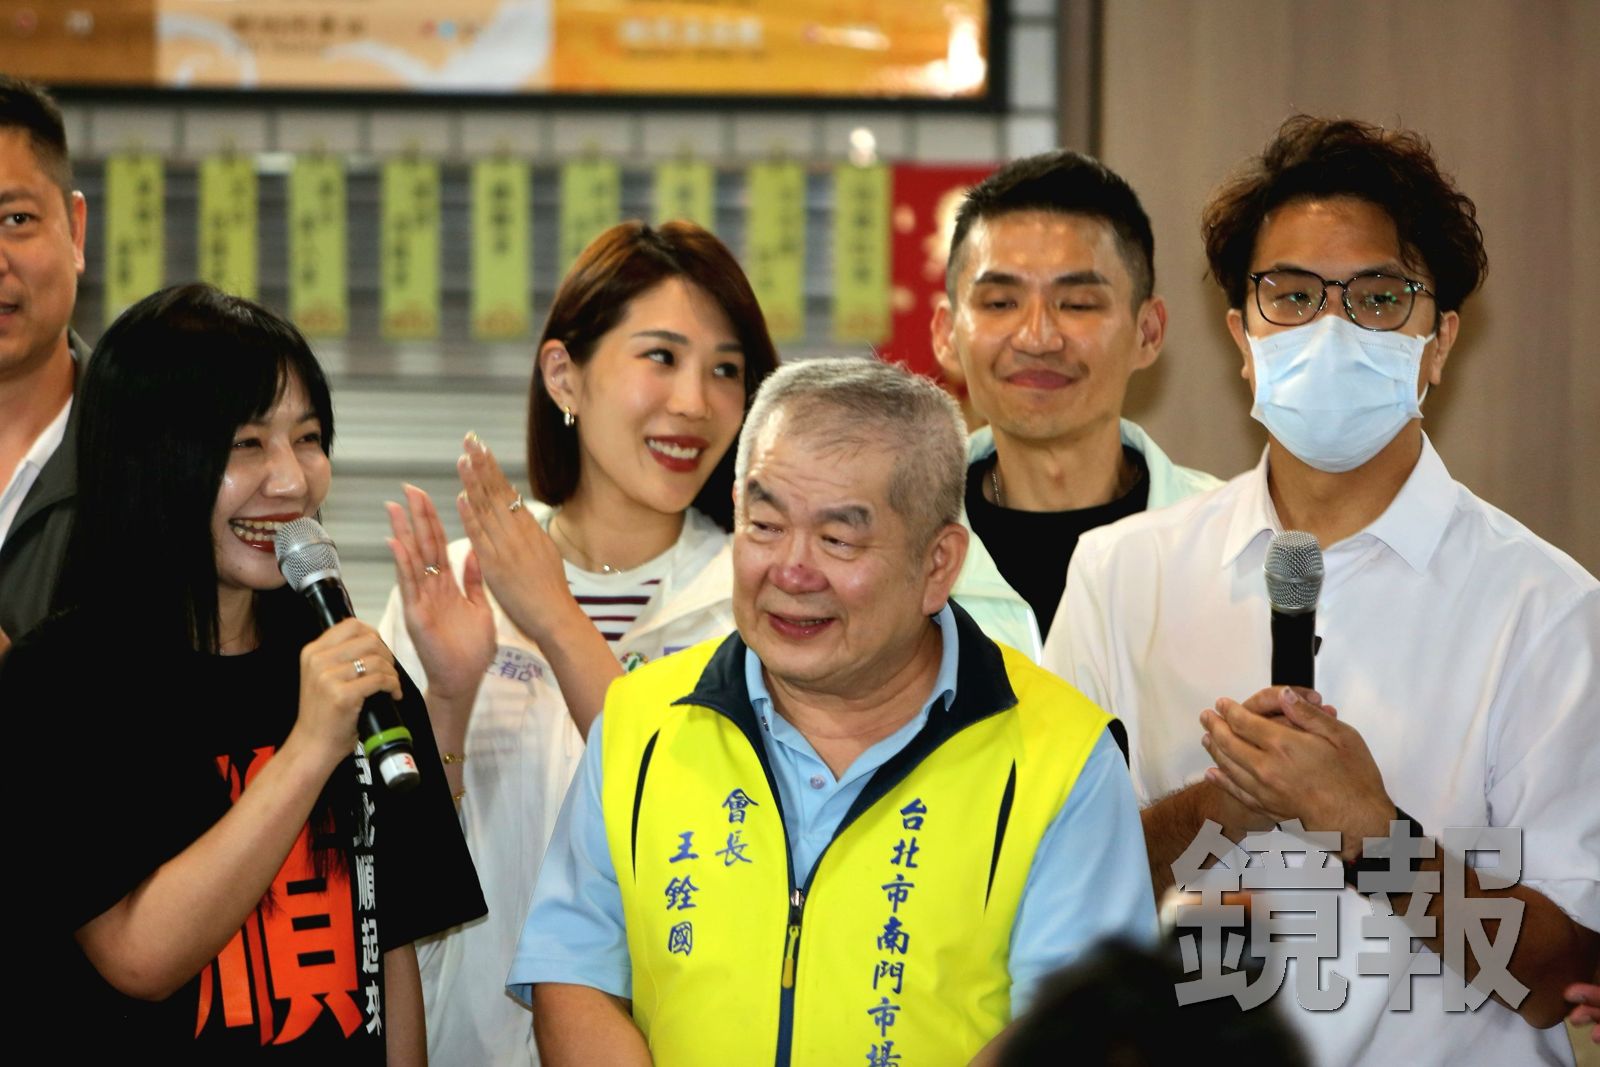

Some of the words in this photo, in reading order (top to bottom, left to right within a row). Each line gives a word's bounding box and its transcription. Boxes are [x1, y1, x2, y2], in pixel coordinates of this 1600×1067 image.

[715, 787, 760, 867] 會長
[663, 830, 700, 957] 王銓國
